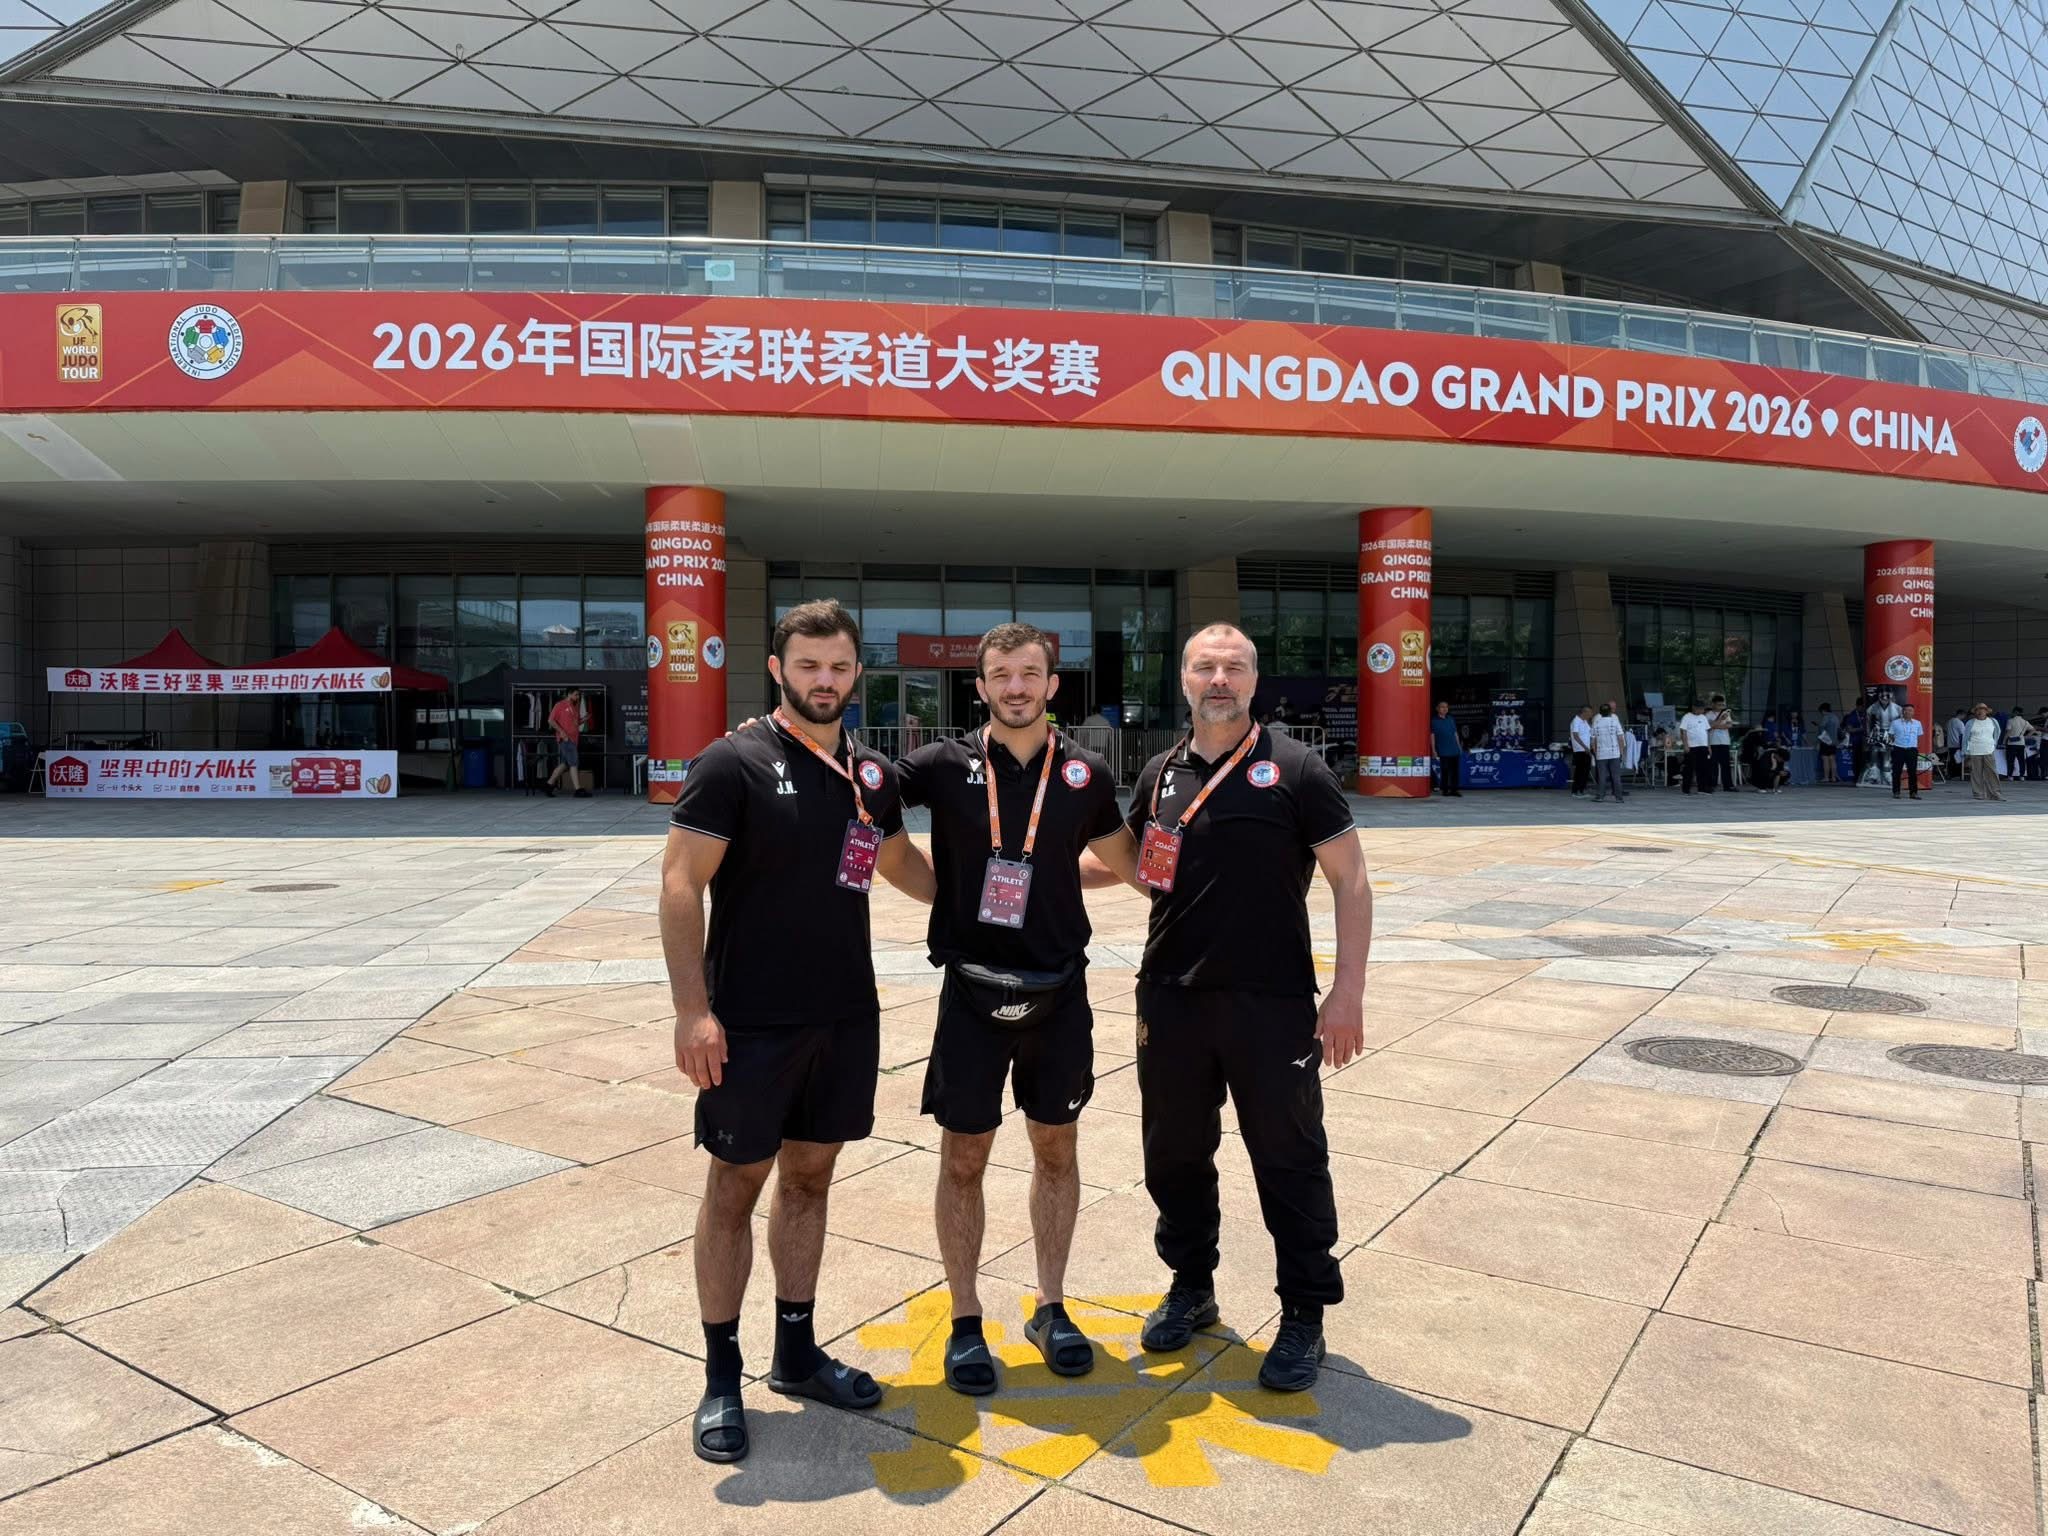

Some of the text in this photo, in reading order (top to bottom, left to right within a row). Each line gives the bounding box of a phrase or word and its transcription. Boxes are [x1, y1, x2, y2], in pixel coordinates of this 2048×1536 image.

[194, 306, 218, 314] JUDO
[63, 345, 98, 355] WORLD
[61, 355, 98, 367] JUDO
[372, 317, 1101, 398] 2026年国际柔联柔道大奖赛
[62, 367, 98, 379] TOUR
[1161, 350, 1420, 407] QINGDAO
[1431, 365, 1605, 419] GRAND
[1616, 380, 1716, 430] PRIX
[1725, 390, 1813, 439] 2026
[1848, 406, 1958, 457] CHINA
[650, 537, 712, 551] QINGDAO
[673, 554, 709, 569] PRIX
[656, 573, 705, 587] CHINA
[1360, 570, 1406, 584] GRAND
[1390, 587, 1429, 600] CHINA
[1876, 593, 1922, 605] GRAND
[670, 648, 696, 656] WORLD
[669, 655, 696, 663] JUDO
[669, 663, 696, 672] TOUR
[1402, 668, 1423, 677] TOUR
[99, 672, 366, 691] 沃隆三好坚果 坚果中的大队长
[53, 764, 85, 783] 沃隆
[98, 758, 257, 779] 坚果中的大队长
[849, 838, 875, 851] ATHLETE
[1154, 840, 1177, 853] COACH
[991, 875, 1025, 887] ATHLETE
[999, 1002, 1030, 1017] NIKE
